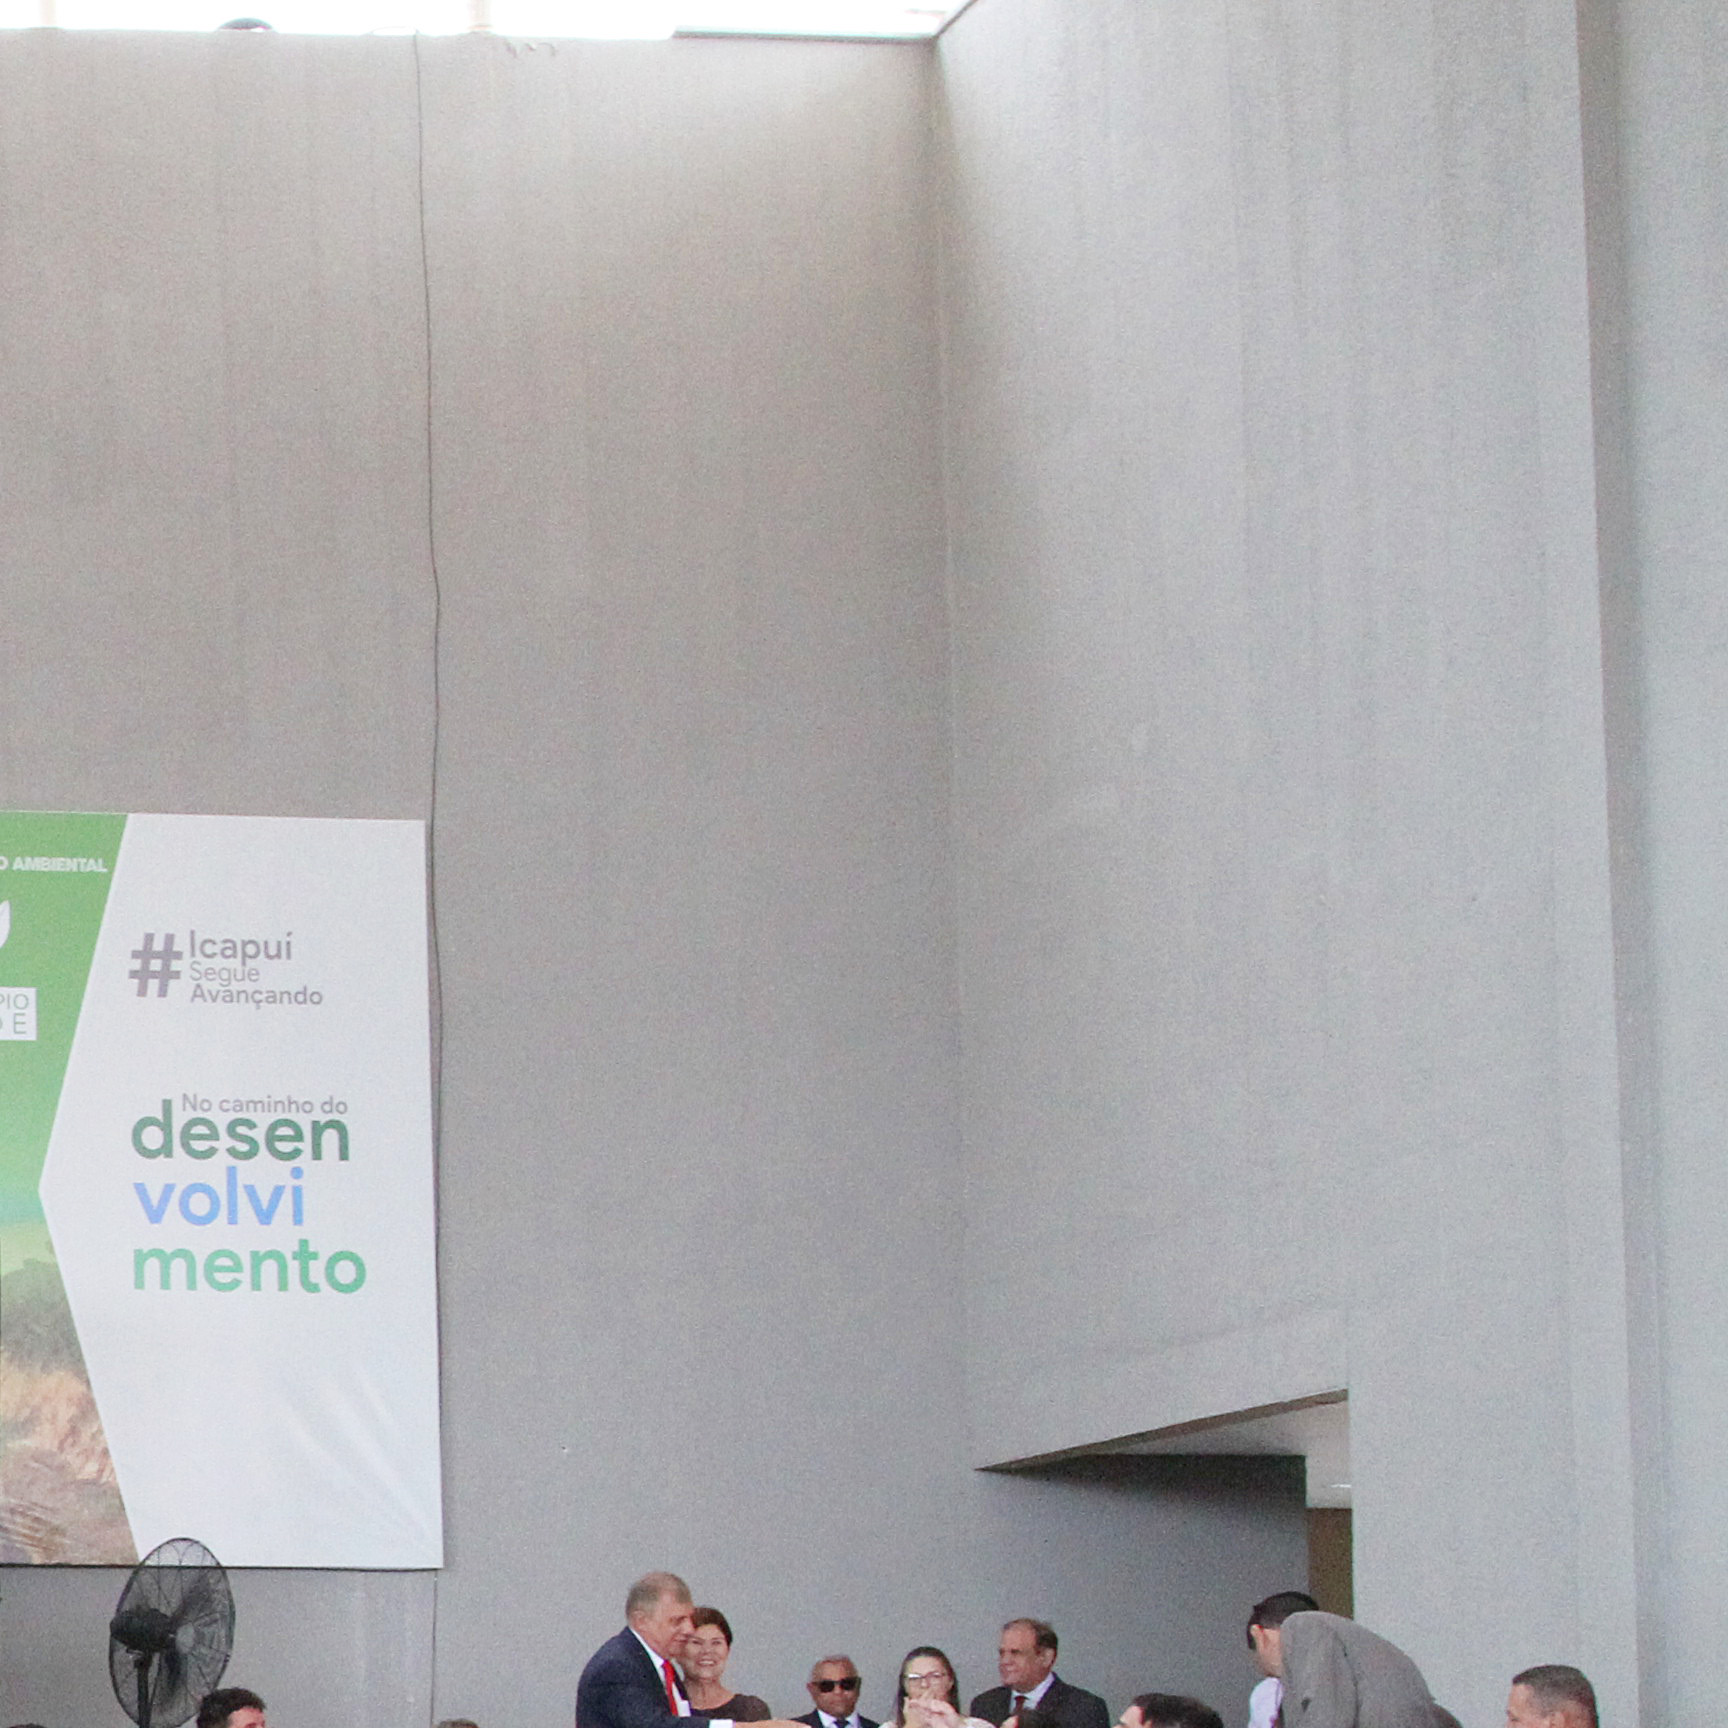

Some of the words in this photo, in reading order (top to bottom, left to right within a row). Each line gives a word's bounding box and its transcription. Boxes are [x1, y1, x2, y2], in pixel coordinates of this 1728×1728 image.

[13, 856, 108, 873] AMBIENTAL
[190, 930, 293, 964] Icapuí
[190, 962, 260, 984] Segue
[190, 986, 323, 1009] Avançando
[182, 1094, 211, 1112] No
[218, 1094, 313, 1114] caminho
[320, 1095, 349, 1115] do
[131, 1099, 350, 1161] desen
[133, 1166, 304, 1226] volvi
[133, 1238, 367, 1293] mento
